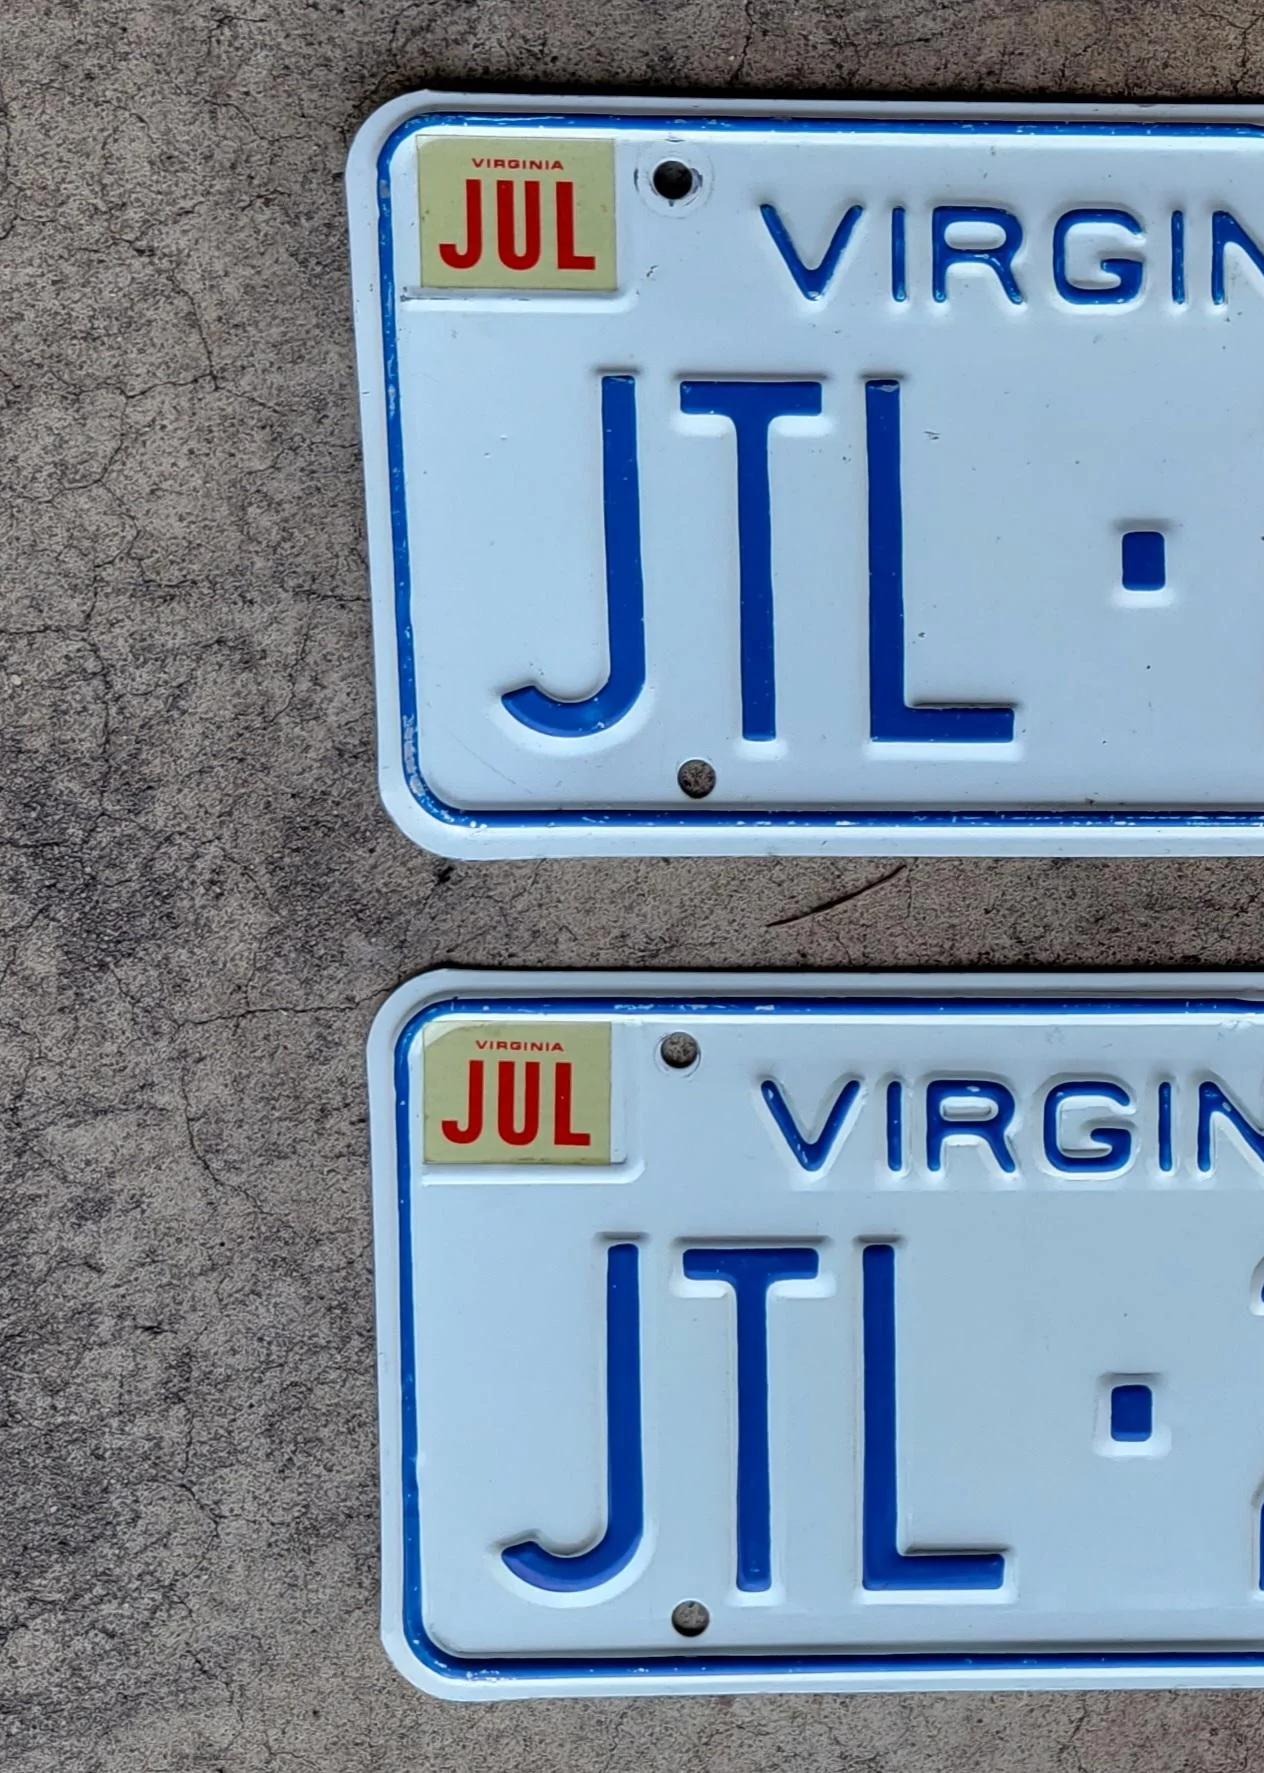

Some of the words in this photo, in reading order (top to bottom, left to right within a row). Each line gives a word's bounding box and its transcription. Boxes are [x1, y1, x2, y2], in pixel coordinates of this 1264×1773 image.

[471, 157, 565, 171] VIRGINIA
[438, 178, 596, 271] JUL
[500, 373, 1015, 744] JTL
[474, 1039, 565, 1052] VIRGINIA
[440, 1059, 591, 1146] JUL
[500, 1242, 1006, 1594] JTL
